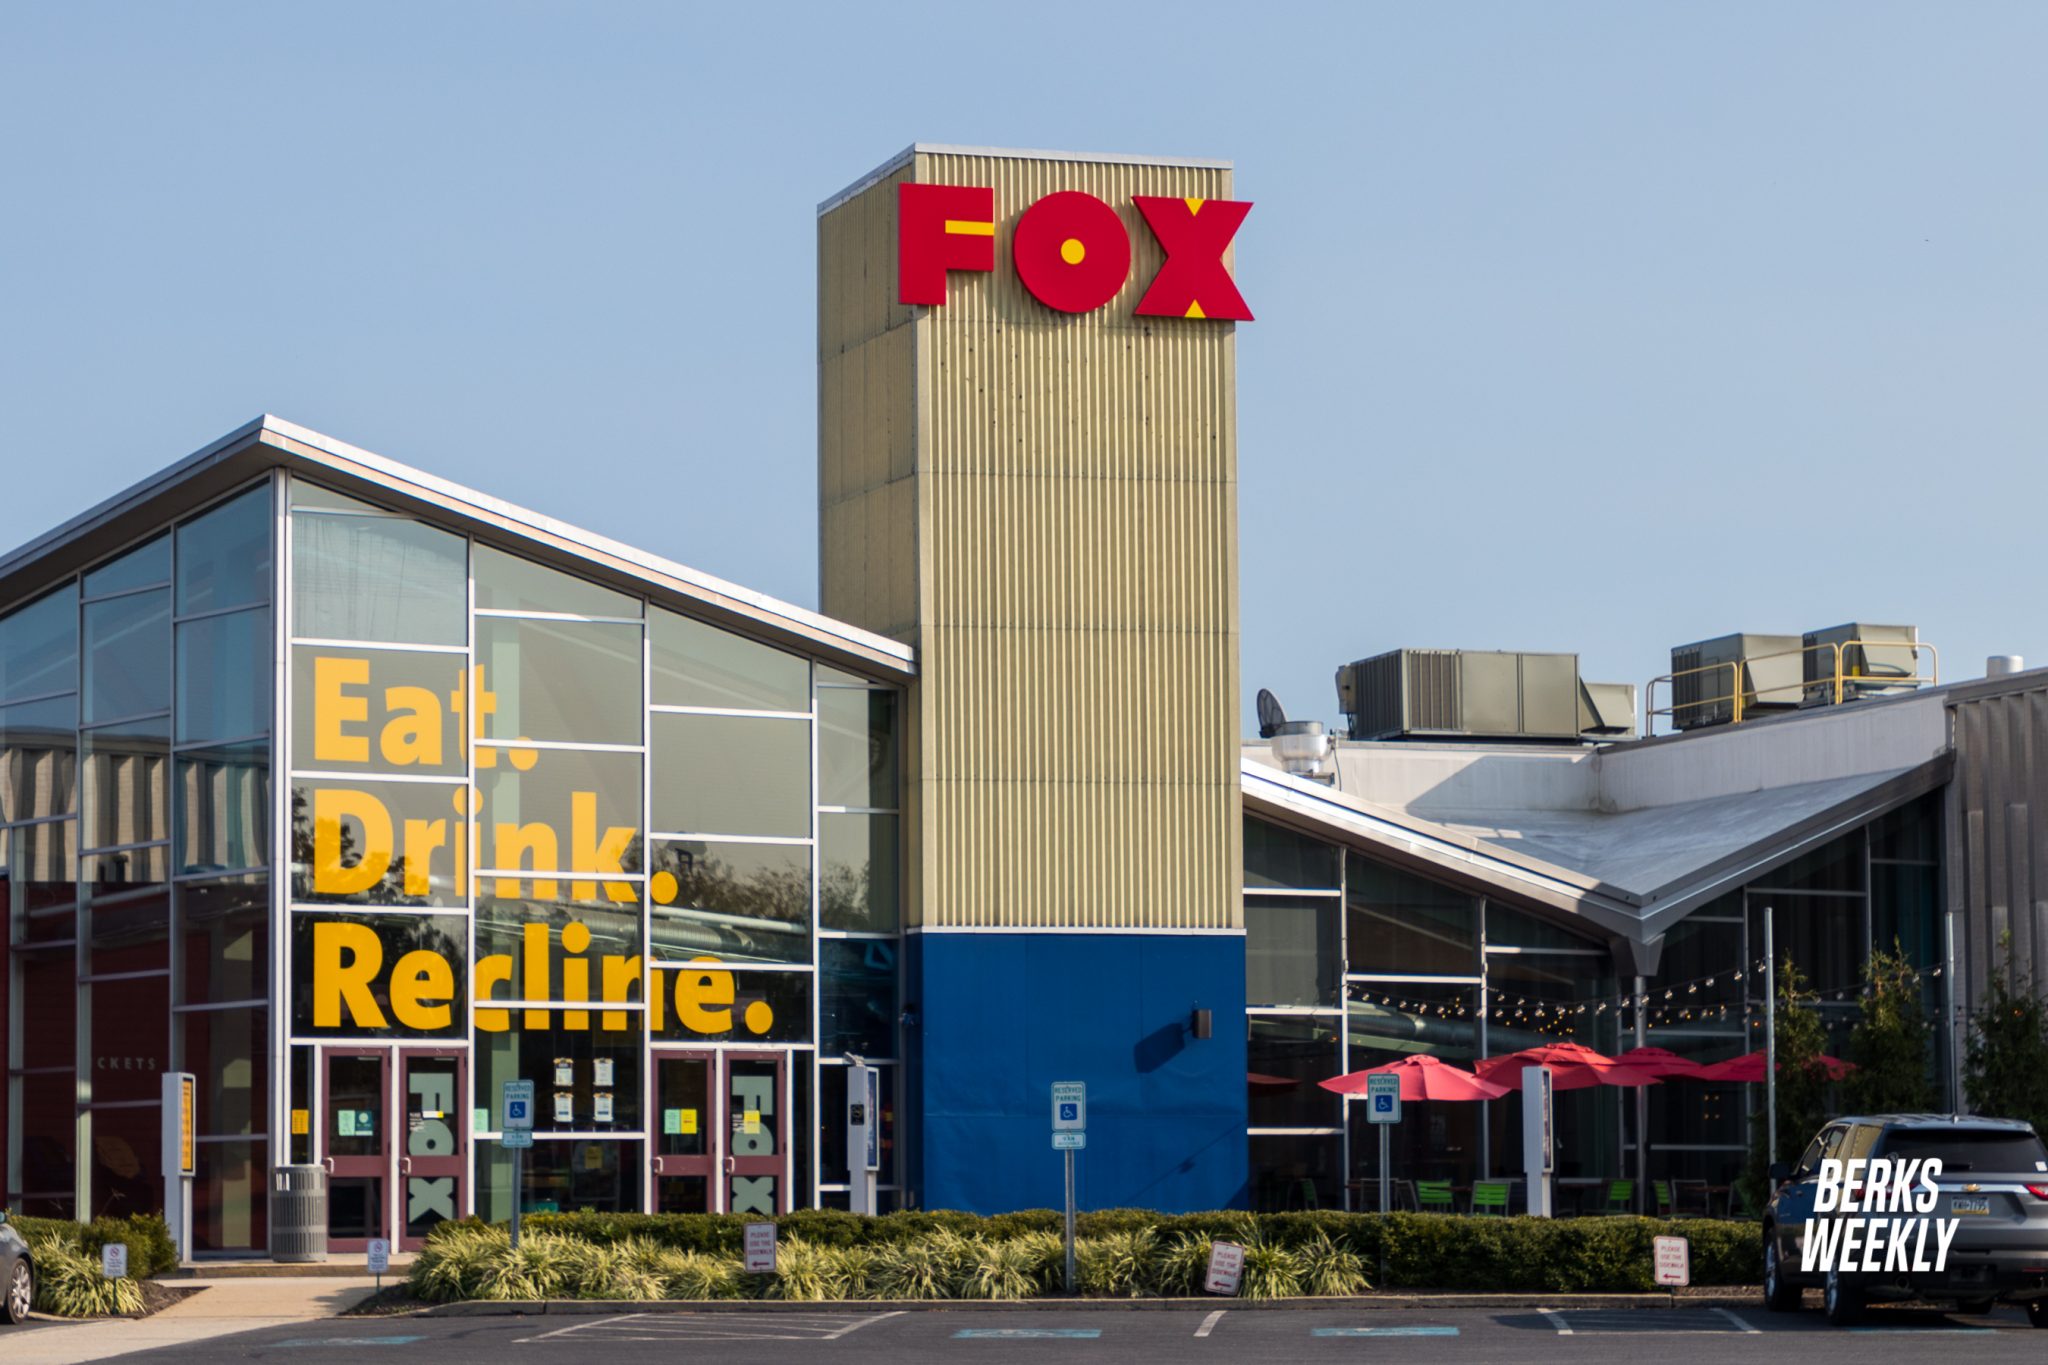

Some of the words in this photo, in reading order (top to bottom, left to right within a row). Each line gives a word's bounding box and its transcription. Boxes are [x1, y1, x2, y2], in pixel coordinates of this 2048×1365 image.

[898, 183, 1254, 321] FOX
[314, 656, 539, 771] Eat.
[314, 788, 679, 905] Drink.
[313, 922, 774, 1035] Recline.
[97, 1057, 157, 1070] CKETS
[408, 1073, 454, 1225] FOX
[731, 1075, 774, 1216] FOX
[1217, 1251, 1238, 1260] PLEASE
